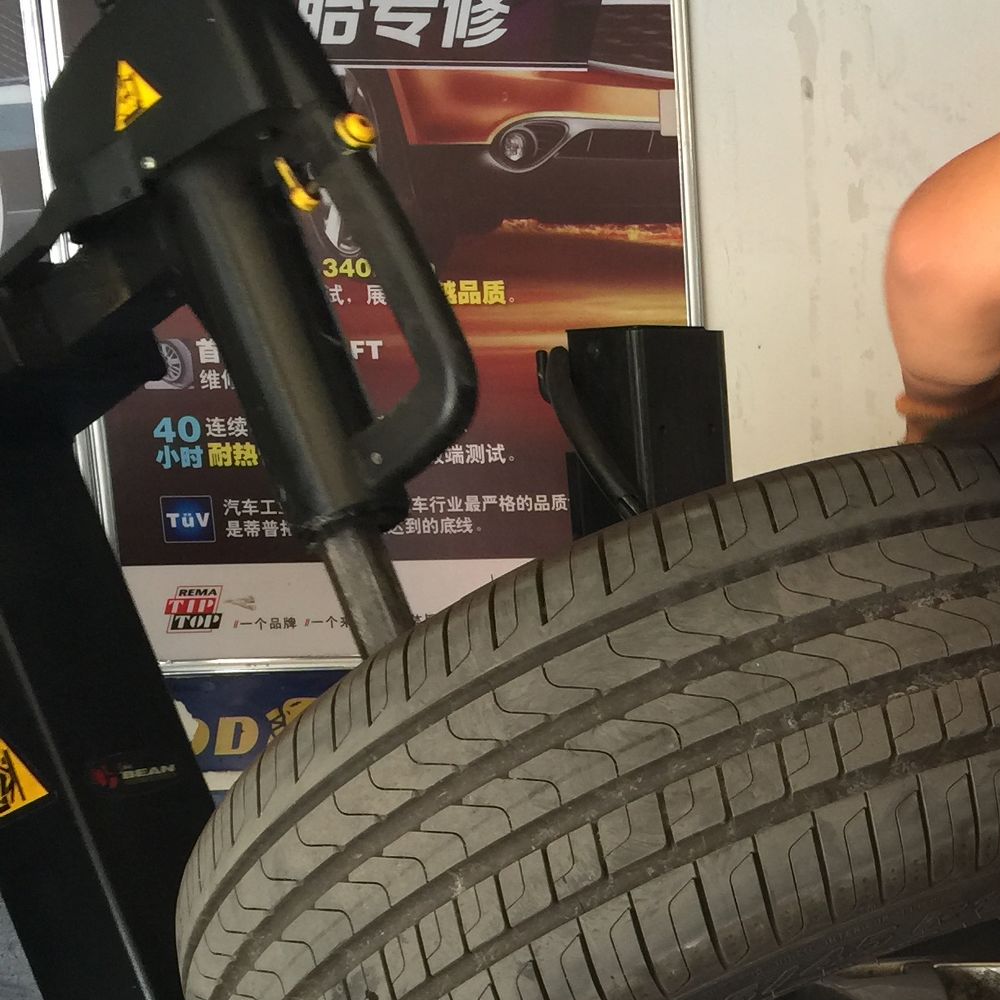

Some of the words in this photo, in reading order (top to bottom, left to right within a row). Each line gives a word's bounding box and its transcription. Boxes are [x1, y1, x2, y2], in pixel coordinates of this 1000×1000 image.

[322, 258, 373, 278] 340
[153, 416, 201, 443] 40
[205, 416, 249, 438] 连续
[156, 446, 203, 470] 小时
[178, 588, 217, 597] REMA
[167, 599, 215, 614] TIP
[172, 614, 221, 630] TOP
[239, 617, 297, 630] 一个品牌
